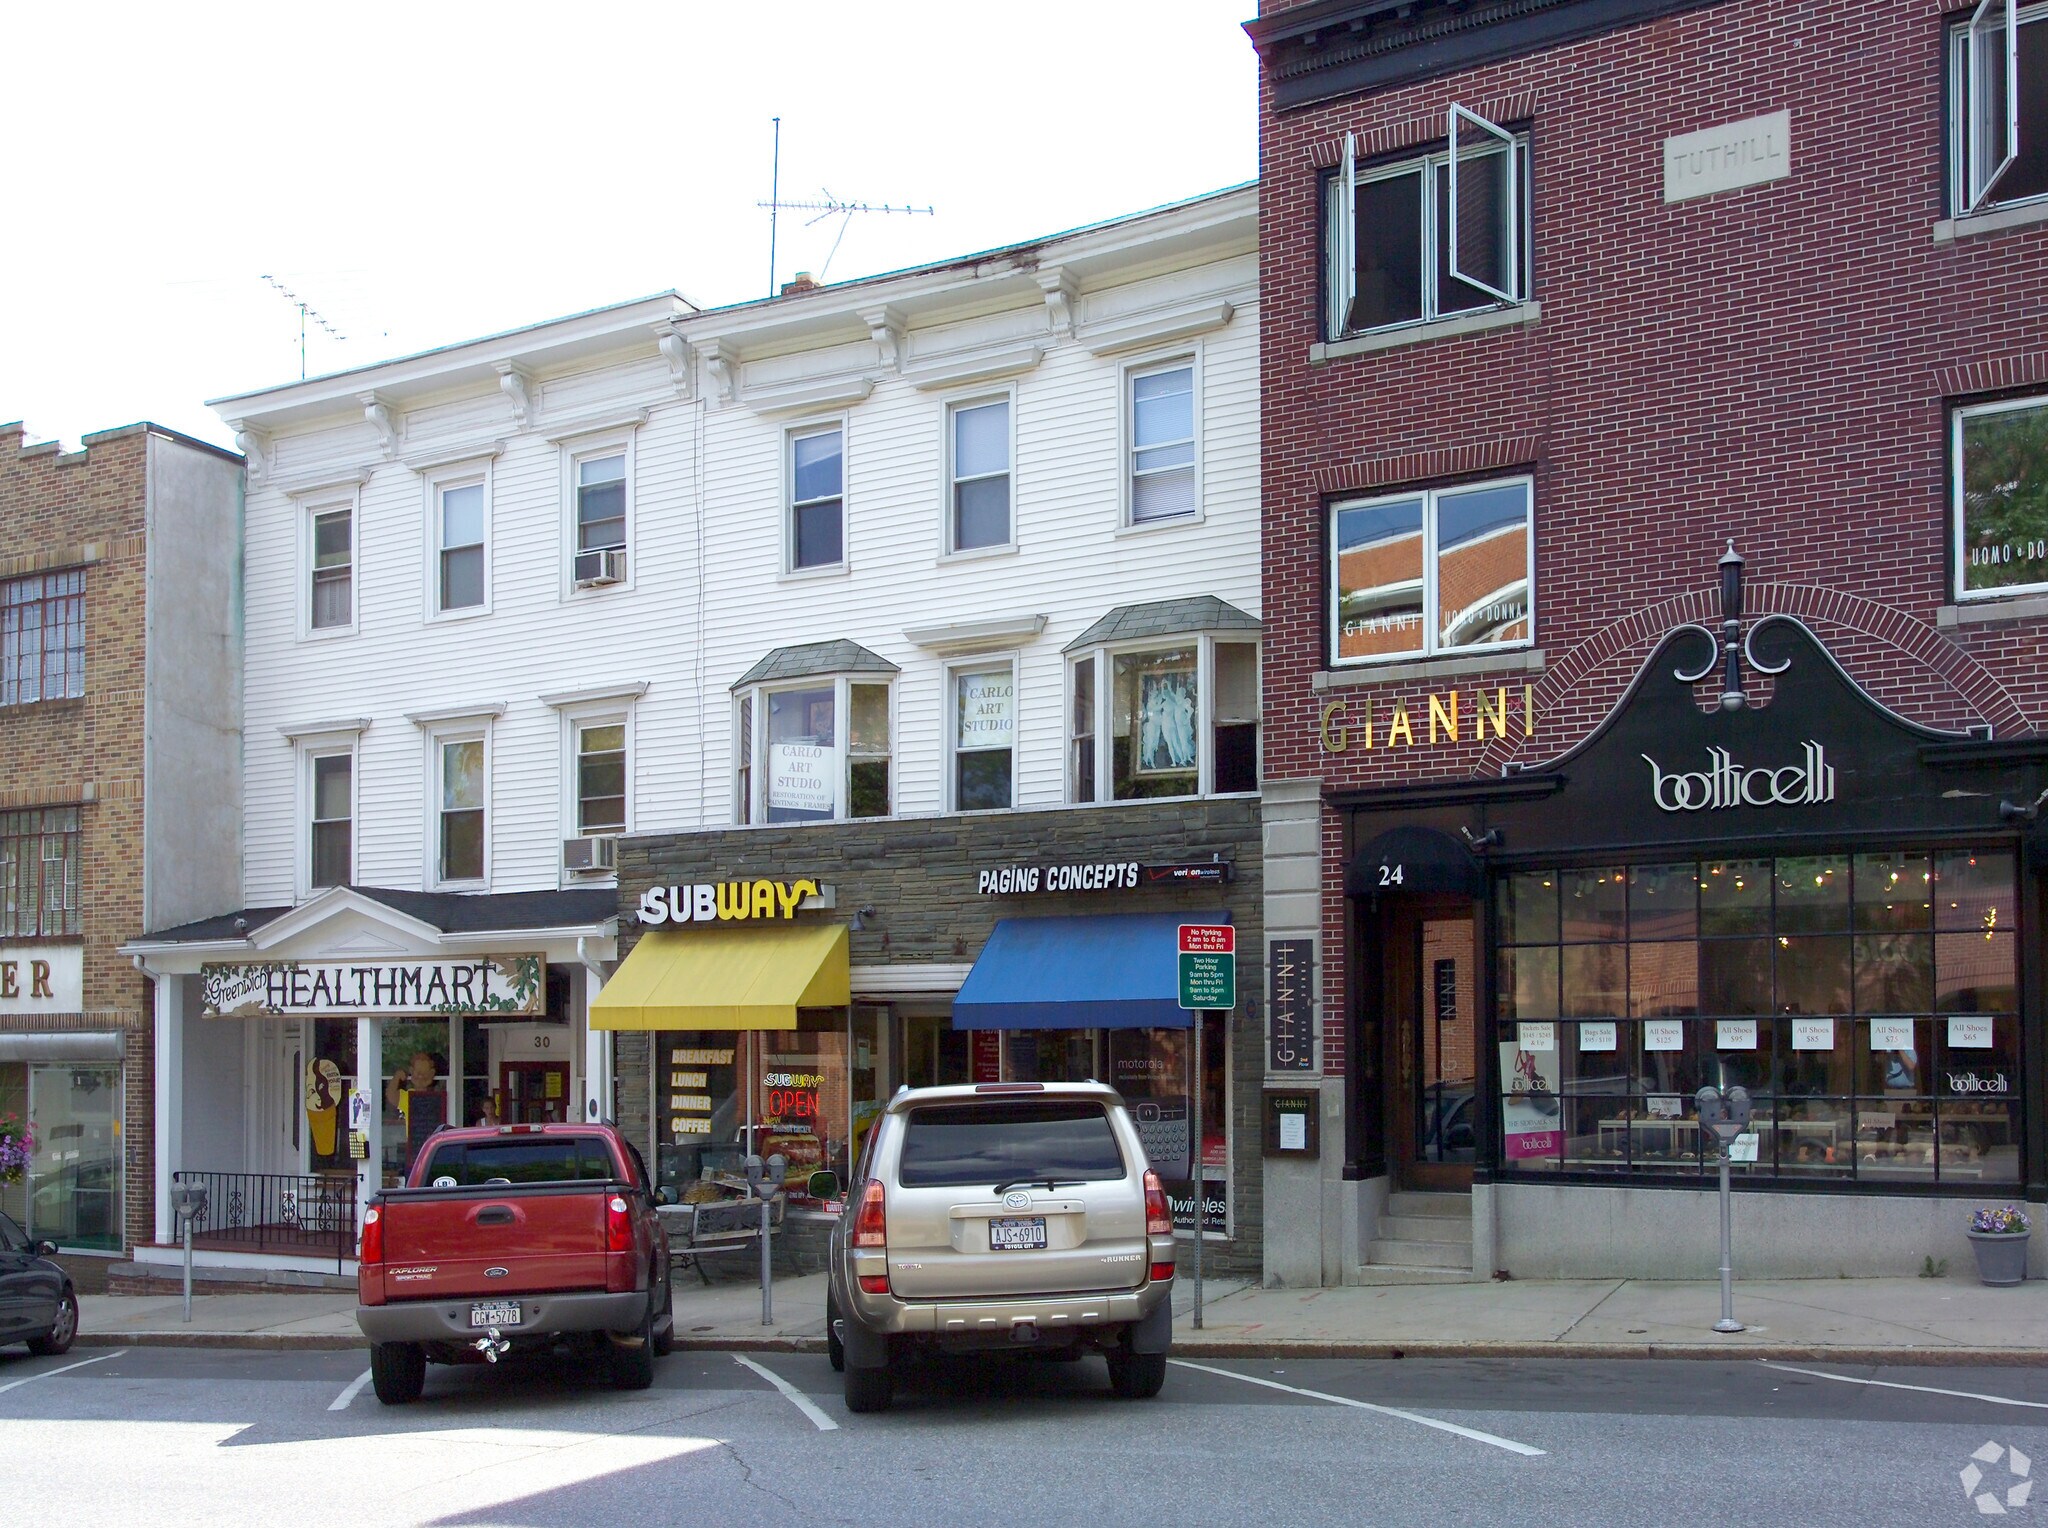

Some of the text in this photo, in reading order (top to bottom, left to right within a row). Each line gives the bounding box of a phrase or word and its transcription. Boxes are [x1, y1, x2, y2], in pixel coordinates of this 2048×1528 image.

[1674, 134, 1780, 180] TUTHILL
[1972, 544, 2010, 566] UOMO
[1487, 602, 1522, 622] DONNA
[1345, 613, 1417, 637] GIANNI
[970, 685, 1013, 699] CARLO
[976, 702, 1004, 715] ART
[964, 719, 1012, 732] STUDIO
[1321, 684, 1533, 752] GIANNI
[782, 746, 822, 758] CARLO
[788, 762, 812, 773] ART
[1641, 739, 1834, 811] botticelli
[777, 776, 821, 789] STUDIO
[773, 791, 815, 800] RESTORATION
[979, 862, 1138, 894] PAGING CONCEPTS
[1379, 864, 1403, 885] 24
[635, 879, 818, 925] SUBWAY
[1201, 929, 1222, 937] Parking
[208, 970, 267, 1005] Greenwich
[265, 964, 497, 1008] HEALTHMART
[1277, 948, 1294, 1062] GIANNI
[534, 1036, 550, 1048] 30
[672, 1049, 735, 1064] BREAKFAST
[1118, 1058, 1163, 1069] motorola
[671, 1072, 707, 1087] LUNCH
[764, 1073, 824, 1088] SUBWAY
[1946, 1072, 2007, 1092] botticelli
[671, 1095, 711, 1110] DINNER
[769, 1090, 820, 1116] OPEN
[671, 1117, 711, 1133] COFFEE
[1174, 1196, 1226, 1213] wirles
[389, 1266, 438, 1274] EXPLORER
